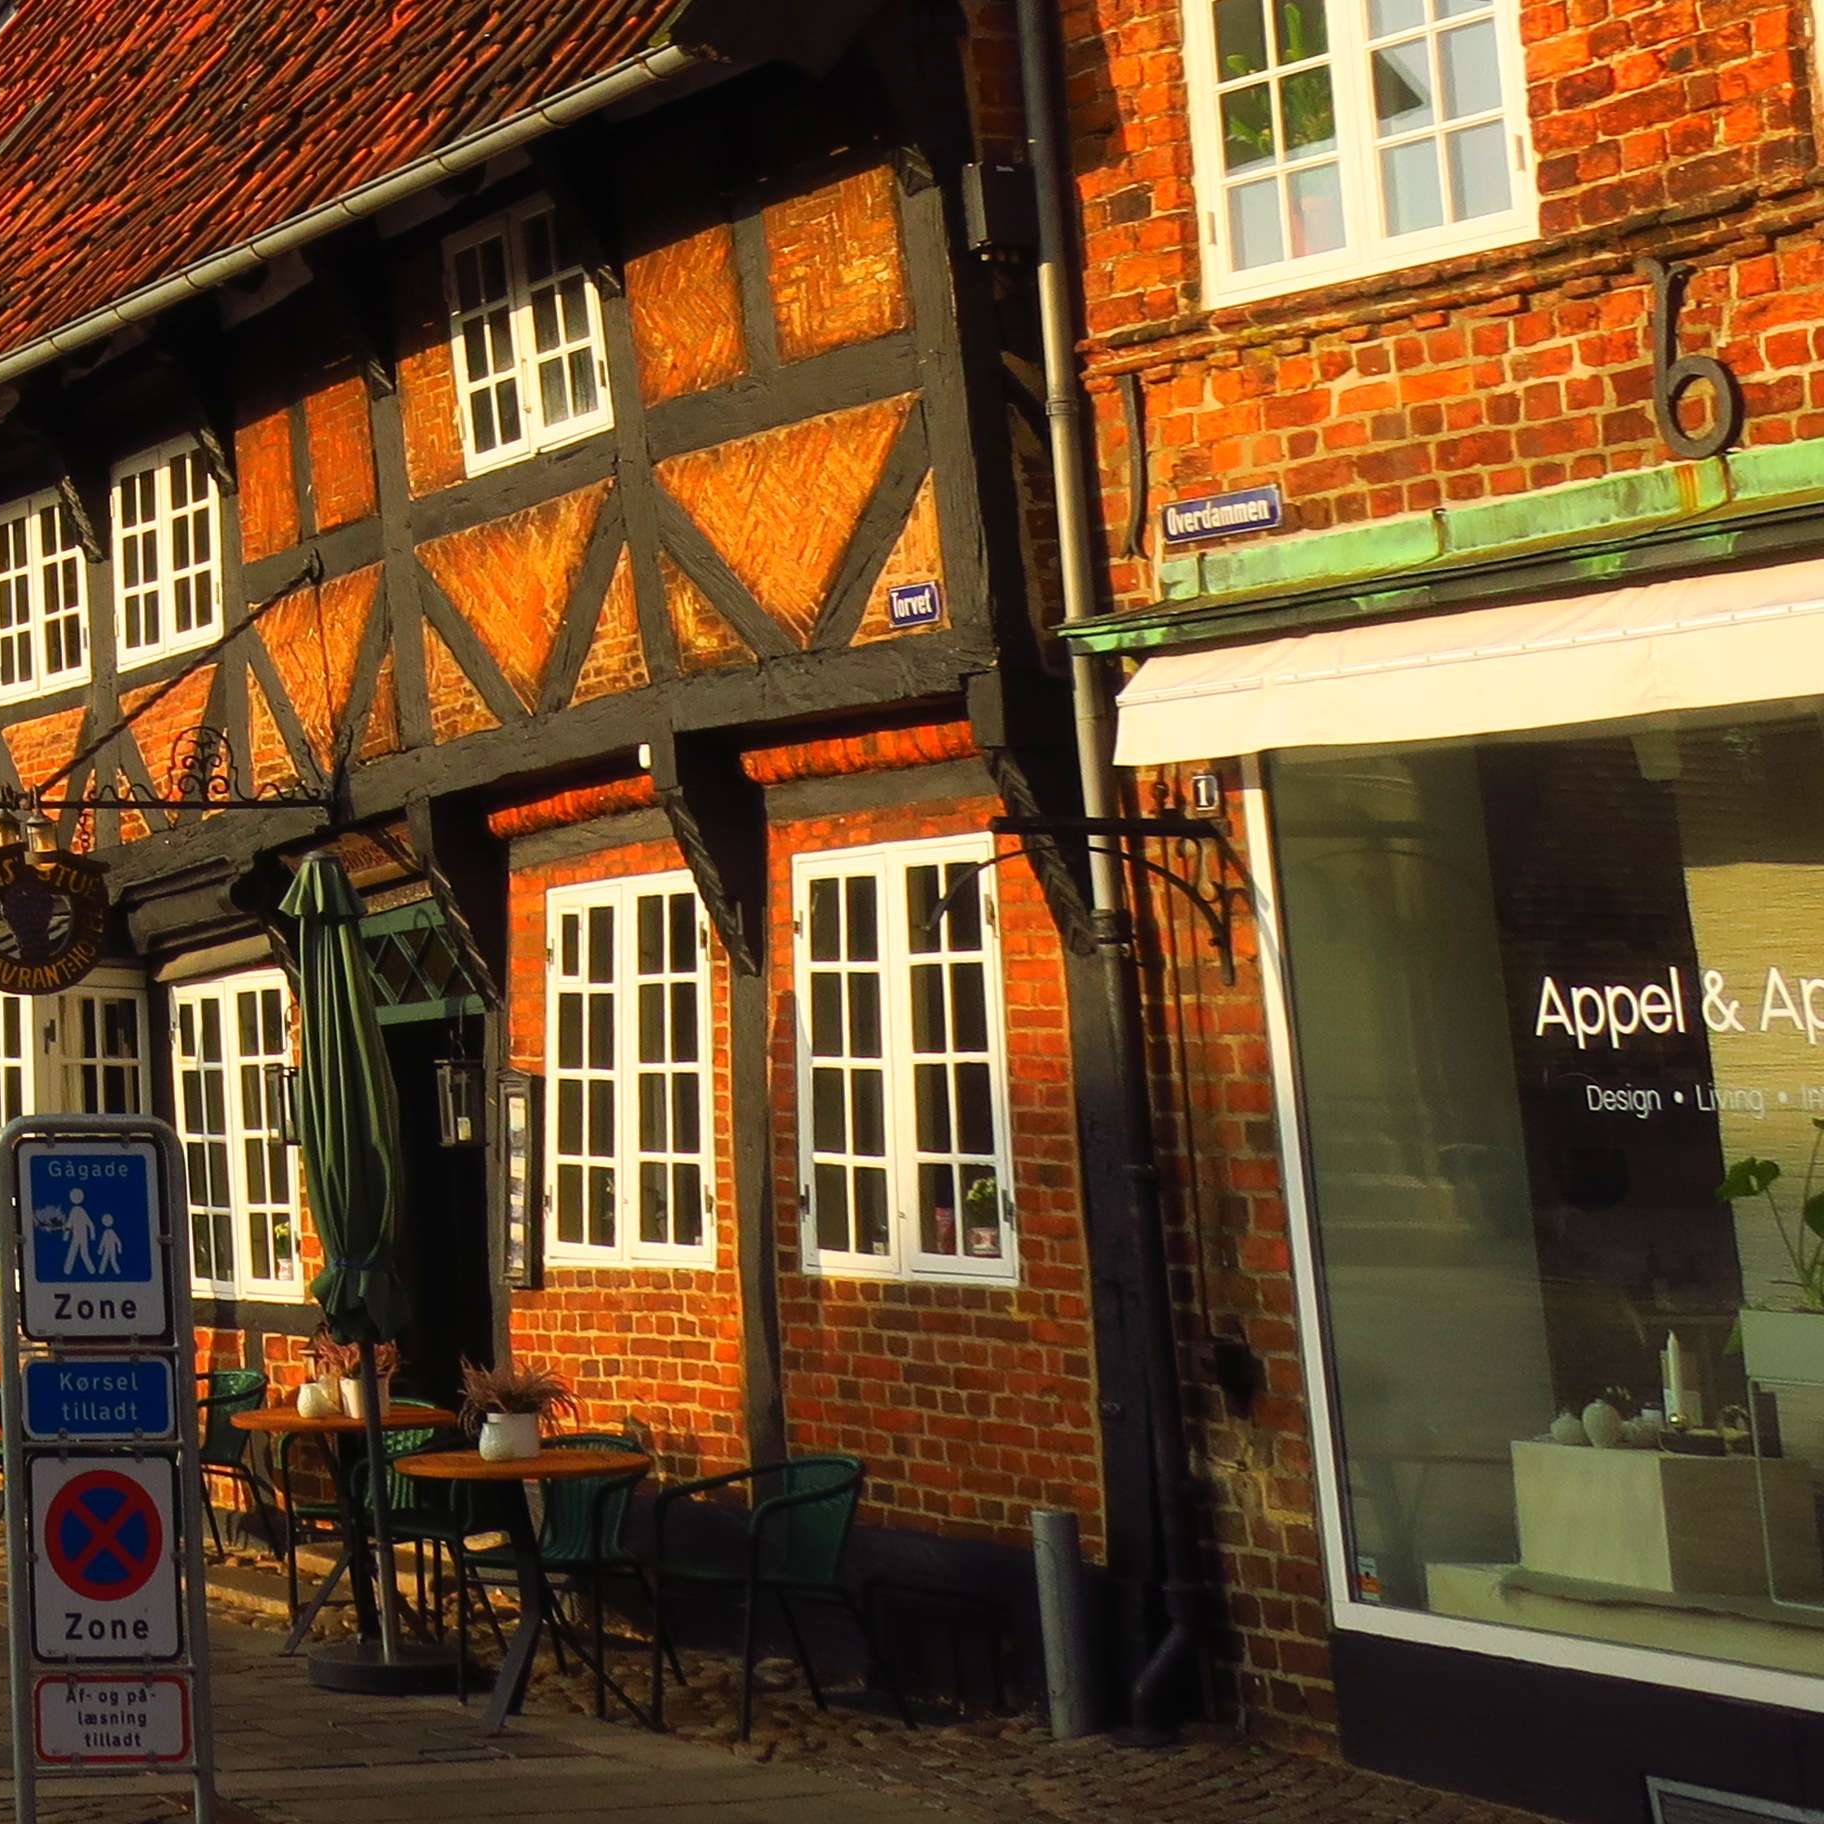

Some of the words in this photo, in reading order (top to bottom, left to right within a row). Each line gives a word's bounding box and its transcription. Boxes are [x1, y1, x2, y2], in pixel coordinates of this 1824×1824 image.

[1166, 499, 1271, 536] Overdammen
[890, 588, 933, 619] Torvet
[1197, 780, 1209, 806] 1
[1535, 966, 1686, 1050] Appel
[1702, 970, 1746, 1033] &
[1585, 1083, 1662, 1119] Design
[1695, 1083, 1764, 1119] Living
[48, 1160, 129, 1181] Gågade
[54, 1293, 138, 1320] Zone
[59, 1372, 139, 1391] Kørsel
[61, 1401, 139, 1421] tilladt
[65, 1612, 149, 1641] Zone
[98, 1690, 119, 1705] og
[78, 1710, 147, 1727] læsning
[84, 1732, 142, 1747] tilladt
